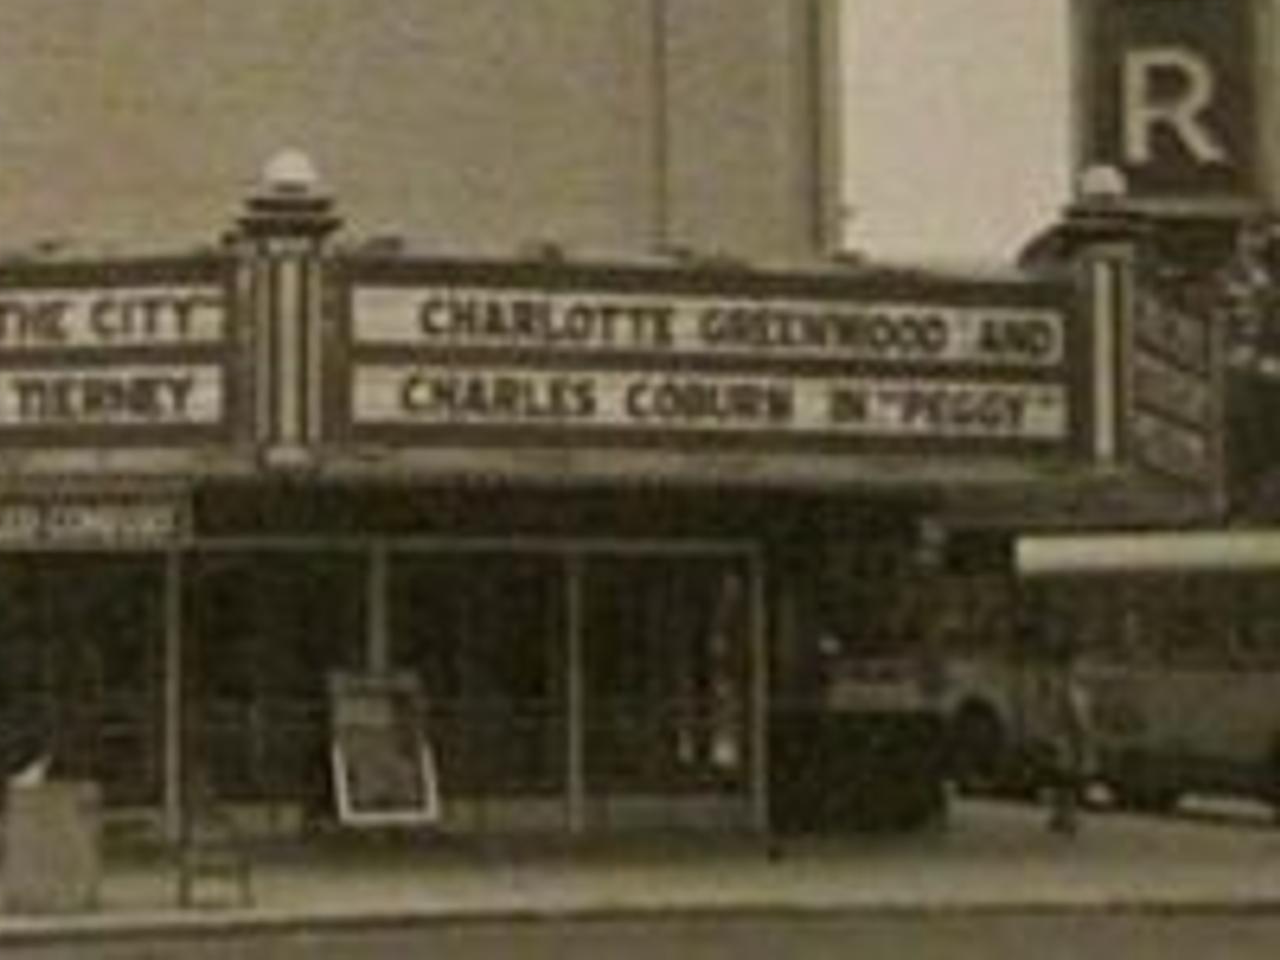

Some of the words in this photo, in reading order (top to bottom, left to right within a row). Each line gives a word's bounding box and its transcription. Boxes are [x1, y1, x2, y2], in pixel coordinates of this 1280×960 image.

[420, 299, 672, 345] CHARLOTTE
[699, 306, 948, 356] GREENWOOD
[979, 314, 1056, 358] AND
[17, 377, 194, 420] TIERNEY
[402, 375, 595, 419] CHARLES
[625, 380, 792, 423] COBURN
[831, 385, 867, 424] IN
